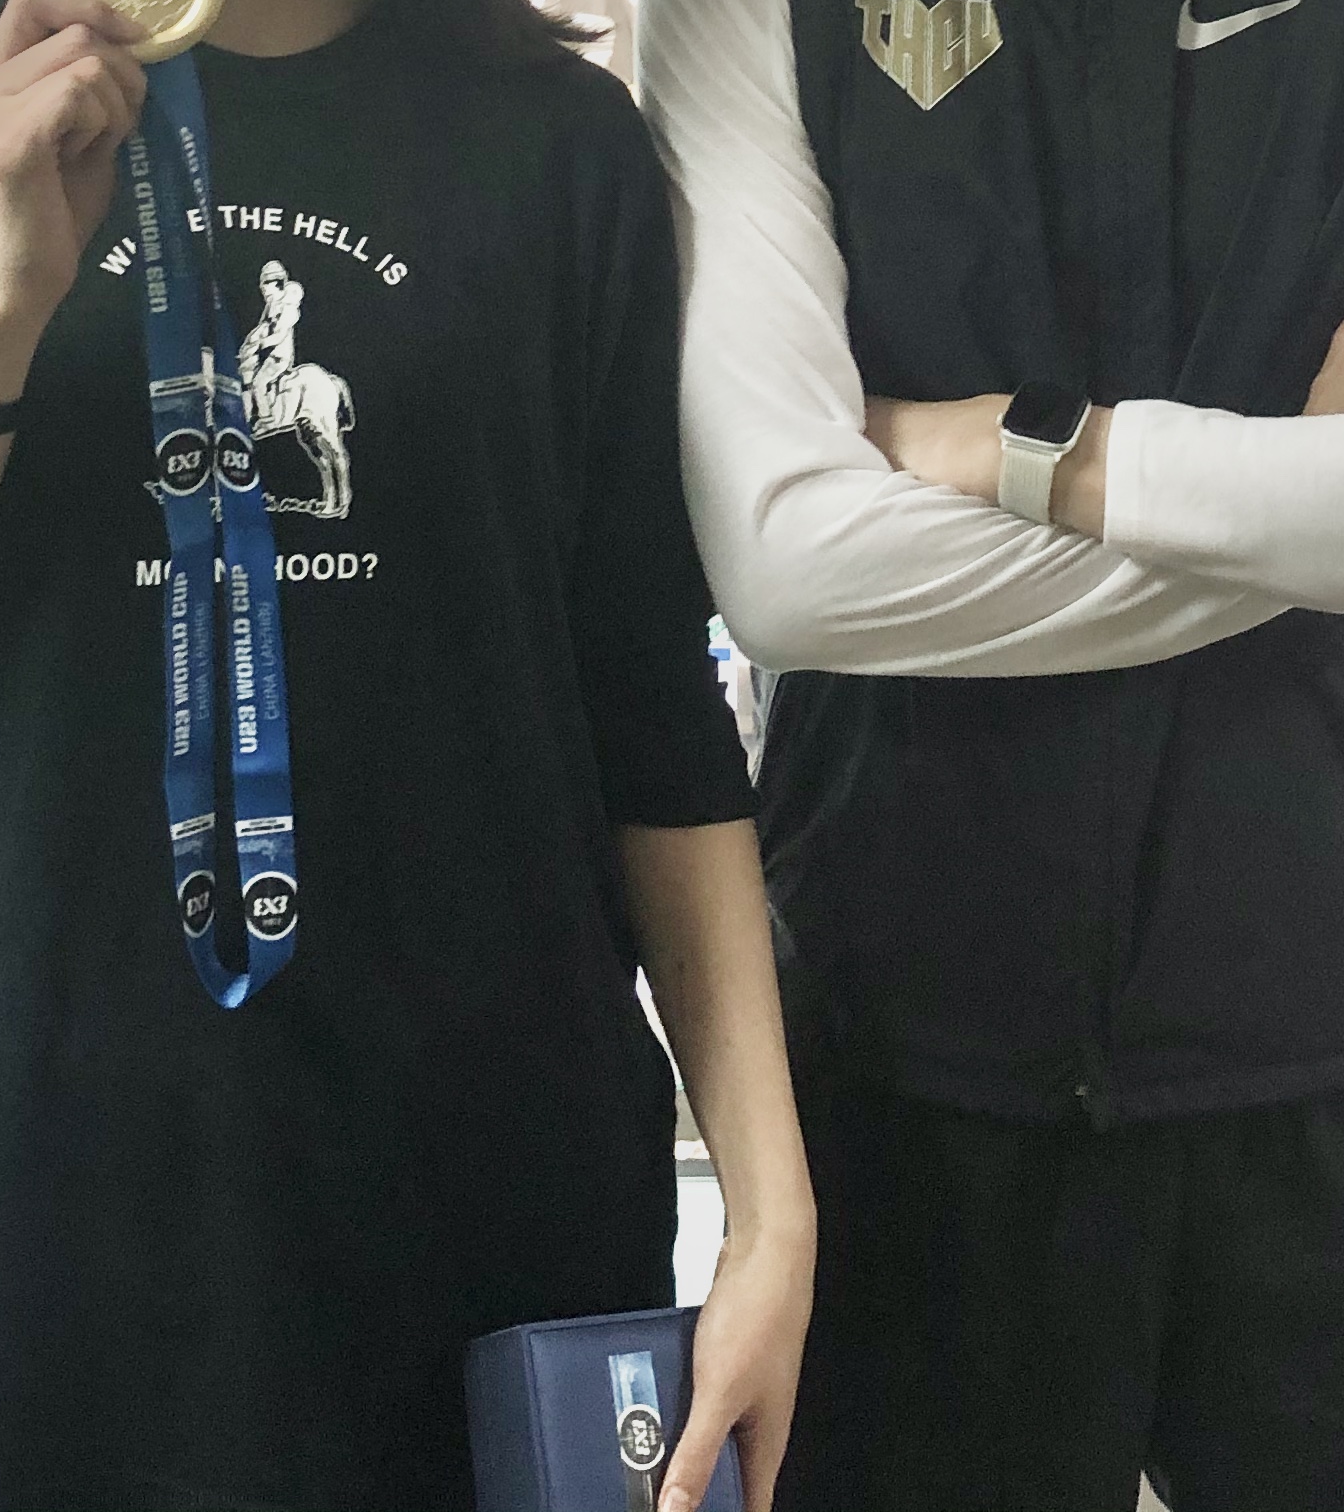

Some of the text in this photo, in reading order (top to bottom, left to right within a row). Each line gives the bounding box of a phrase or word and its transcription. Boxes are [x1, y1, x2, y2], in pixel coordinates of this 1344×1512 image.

[217, 205, 284, 232] THE
[292, 212, 370, 262] HELL
[374, 252, 409, 286] IS
[171, 571, 189, 619] CUP
[231, 564, 252, 614] CUP
[171, 622, 191, 706] WORLD
[232, 617, 256, 701] WORLD
